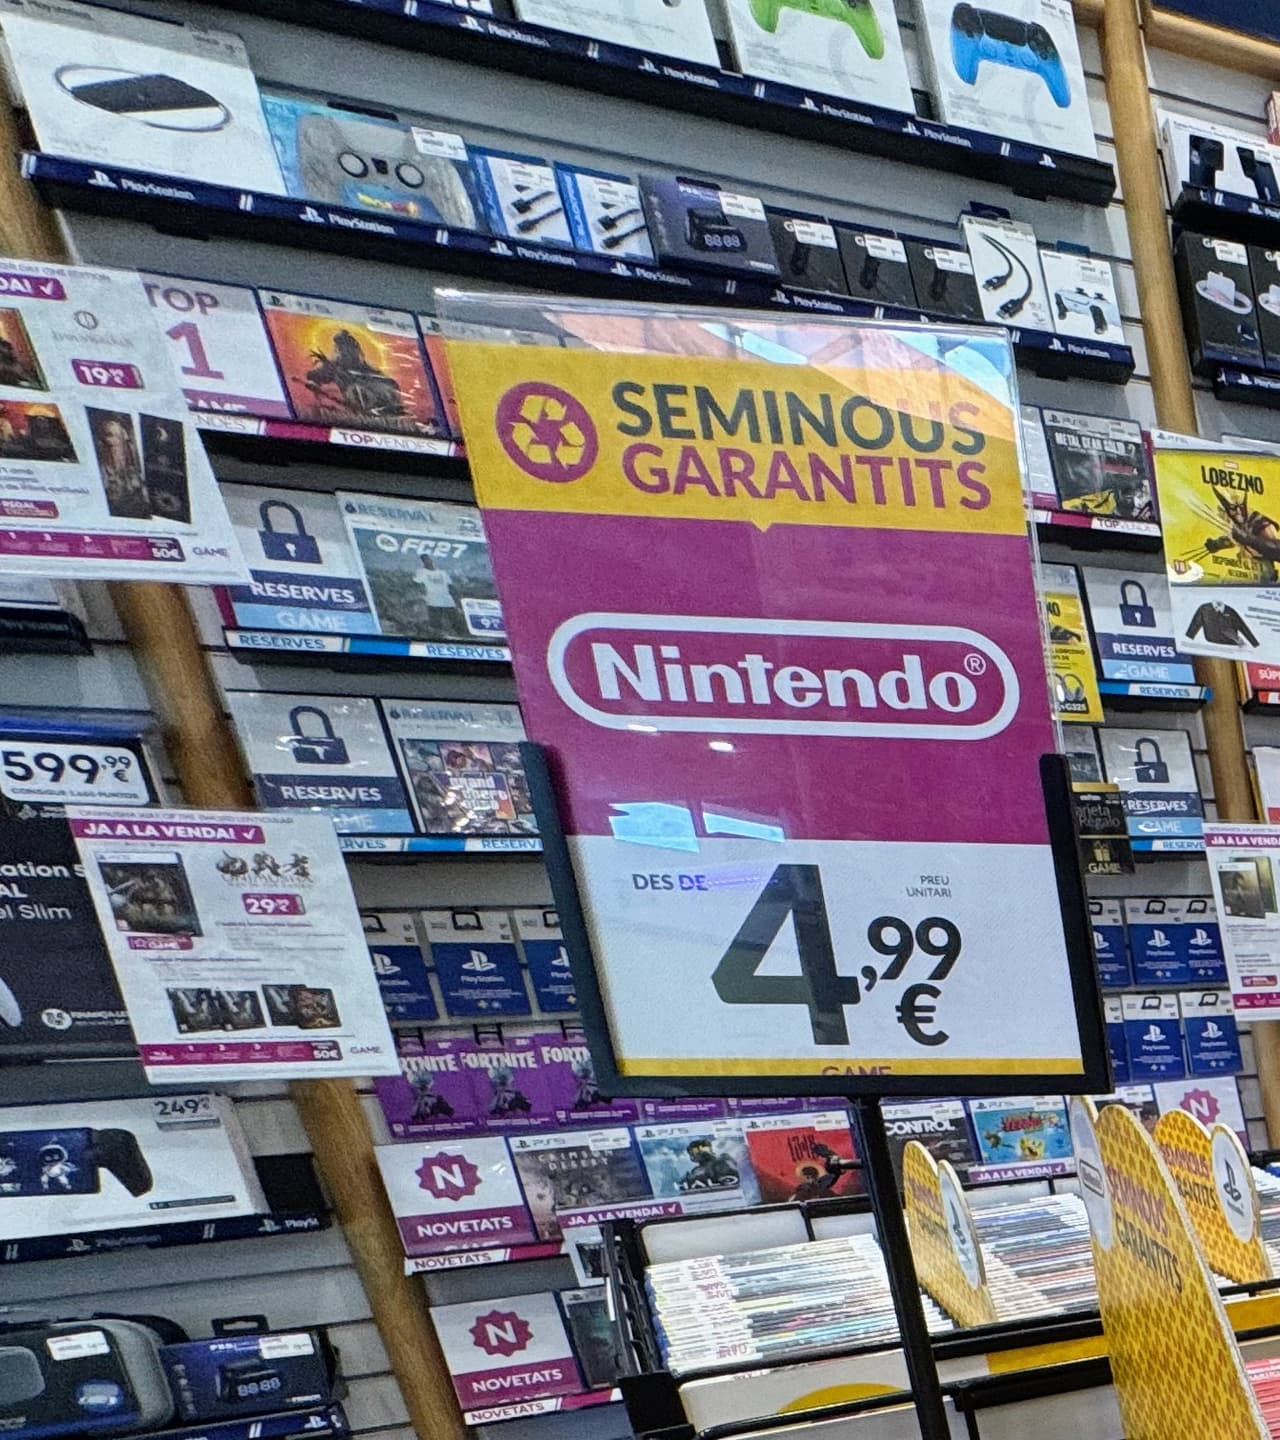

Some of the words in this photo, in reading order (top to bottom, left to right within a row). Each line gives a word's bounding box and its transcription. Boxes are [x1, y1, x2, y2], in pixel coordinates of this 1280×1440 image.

[121, 178, 194, 200] PlayStation
[328, 212, 395, 234] PlayStation
[144, 283, 219, 314] TOP
[165, 322, 225, 380] 1
[611, 381, 987, 456] SEMINOUS
[622, 441, 992, 511] GARANTITS
[1200, 464, 1265, 496] LOBEZNO
[401, 534, 467, 557] FC27
[252, 582, 354, 604] RESERVES
[239, 633, 325, 651] RESERVES
[426, 643, 504, 661] RESERVES
[1112, 641, 1176, 659] RESERVES
[590, 643, 981, 711] Nintendo
[1139, 685, 1191, 699] RESERVES
[281, 784, 381, 802] RESERVES
[1127, 799, 1188, 814] RESERVES
[161, 826, 235, 842] VENDA!
[1088, 861, 1122, 874] GAME
[631, 872, 675, 892] DES
[919, 874, 951, 887] PREU
[906, 886, 953, 899] UNITARI
[21, 903, 73, 922] Slim
[895, 982, 950, 1047] €
[885, 1119, 956, 1137] CONTROL
[417, 1214, 513, 1240] NOVETATS
[413, 1252, 492, 1271] NOVETATS
[1113, 1224, 1182, 1294] GARANTITS
[471, 1367, 563, 1394] NOVETATS
[471, 1402, 546, 1423] NOVETATS
